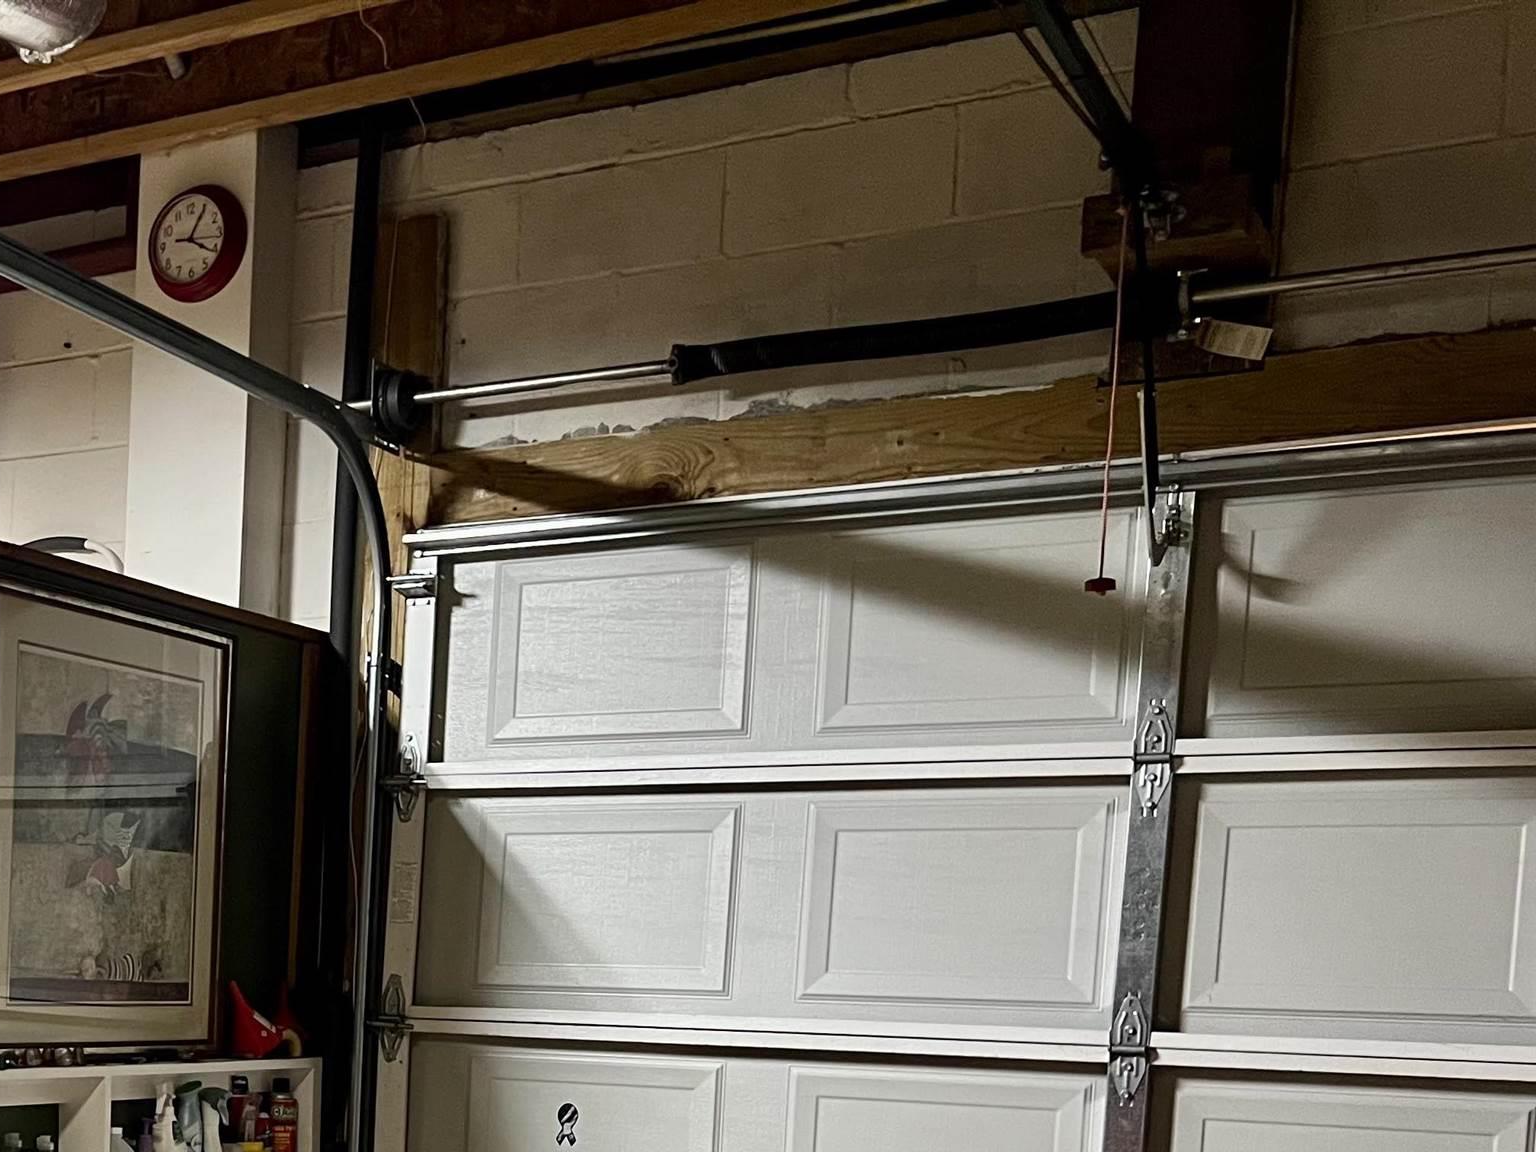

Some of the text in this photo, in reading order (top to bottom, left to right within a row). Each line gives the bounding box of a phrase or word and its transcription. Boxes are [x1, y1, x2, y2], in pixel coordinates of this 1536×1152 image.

[186, 203, 196, 215] 12
[175, 211, 182, 223] 11
[211, 212, 218, 224] 2
[164, 225, 173, 237] 10
[159, 242, 166, 254] 9
[165, 258, 172, 270] 8
[202, 258, 209, 270] 5
[175, 266, 182, 278] 7
[188, 267, 195, 278] 6
